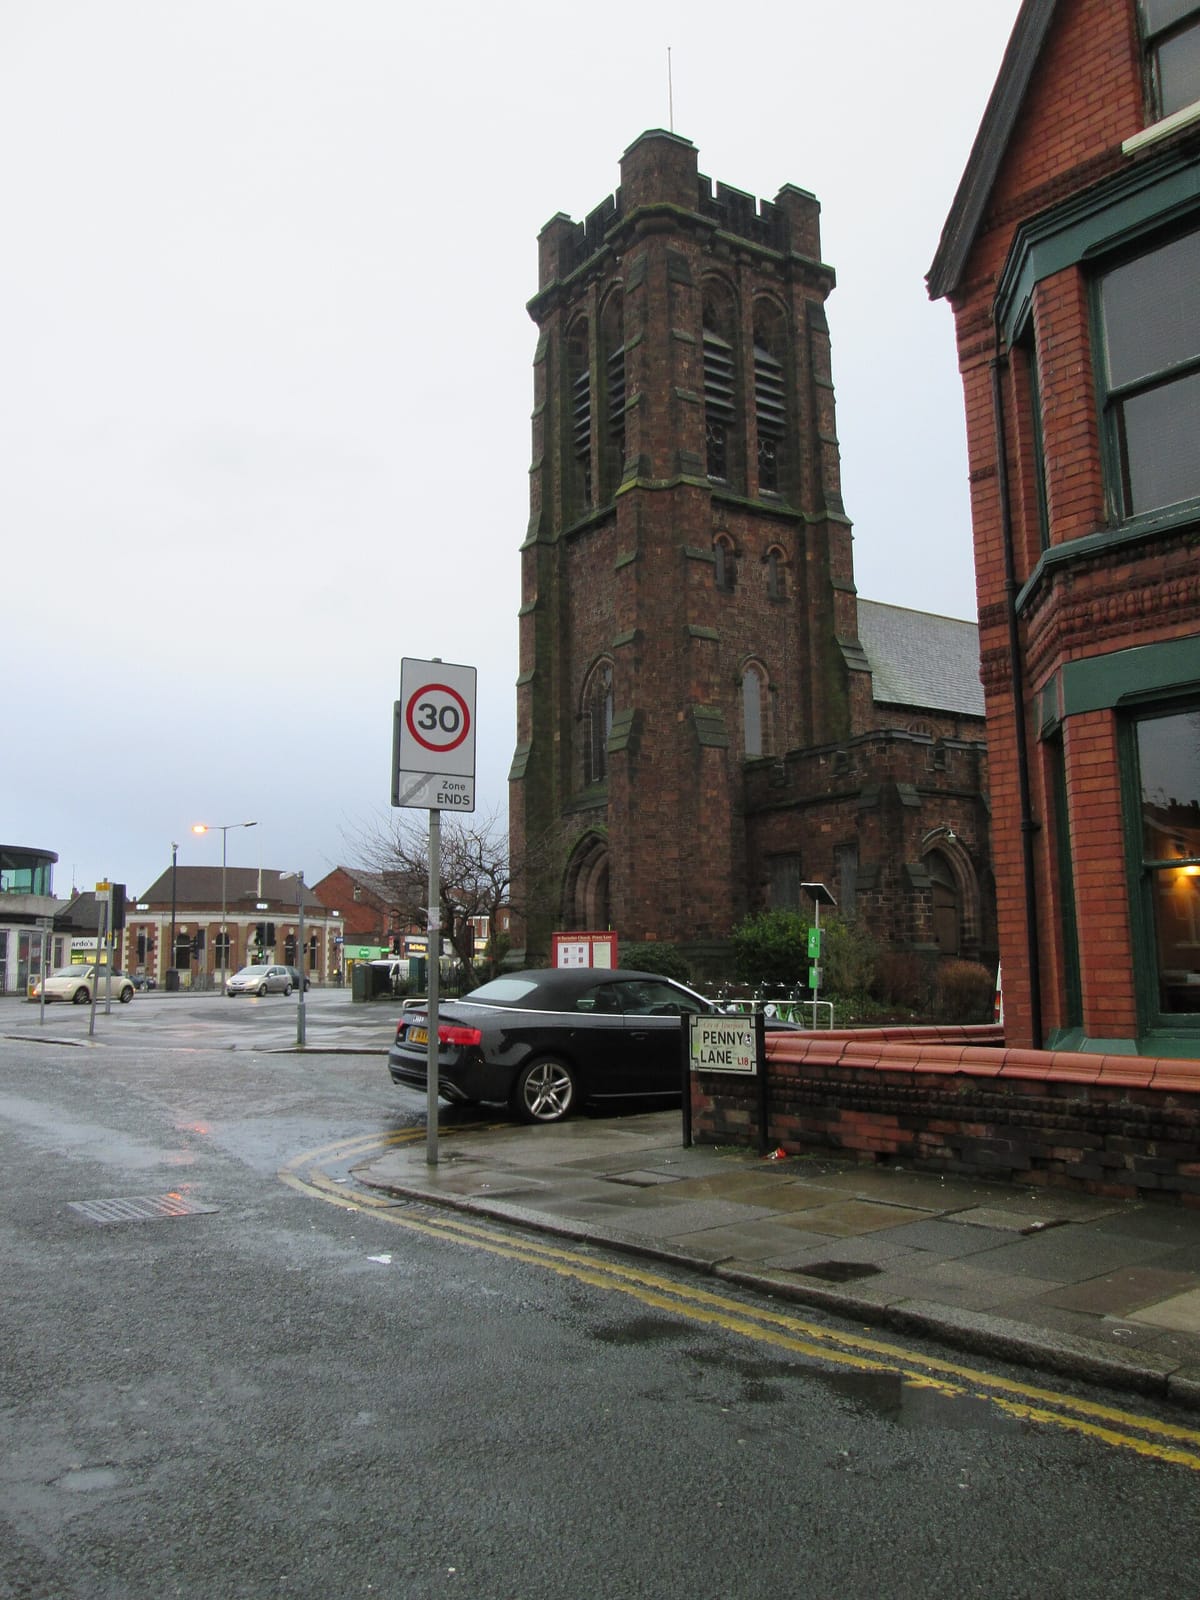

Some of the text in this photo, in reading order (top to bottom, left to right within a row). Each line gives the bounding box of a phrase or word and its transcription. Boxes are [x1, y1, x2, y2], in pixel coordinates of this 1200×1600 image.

[418, 703, 460, 733] 30
[442, 781, 466, 791] Zone
[437, 793, 471, 806] ENDS
[703, 1030, 744, 1046] PENNY
[700, 1049, 749, 1066] LANE L18
